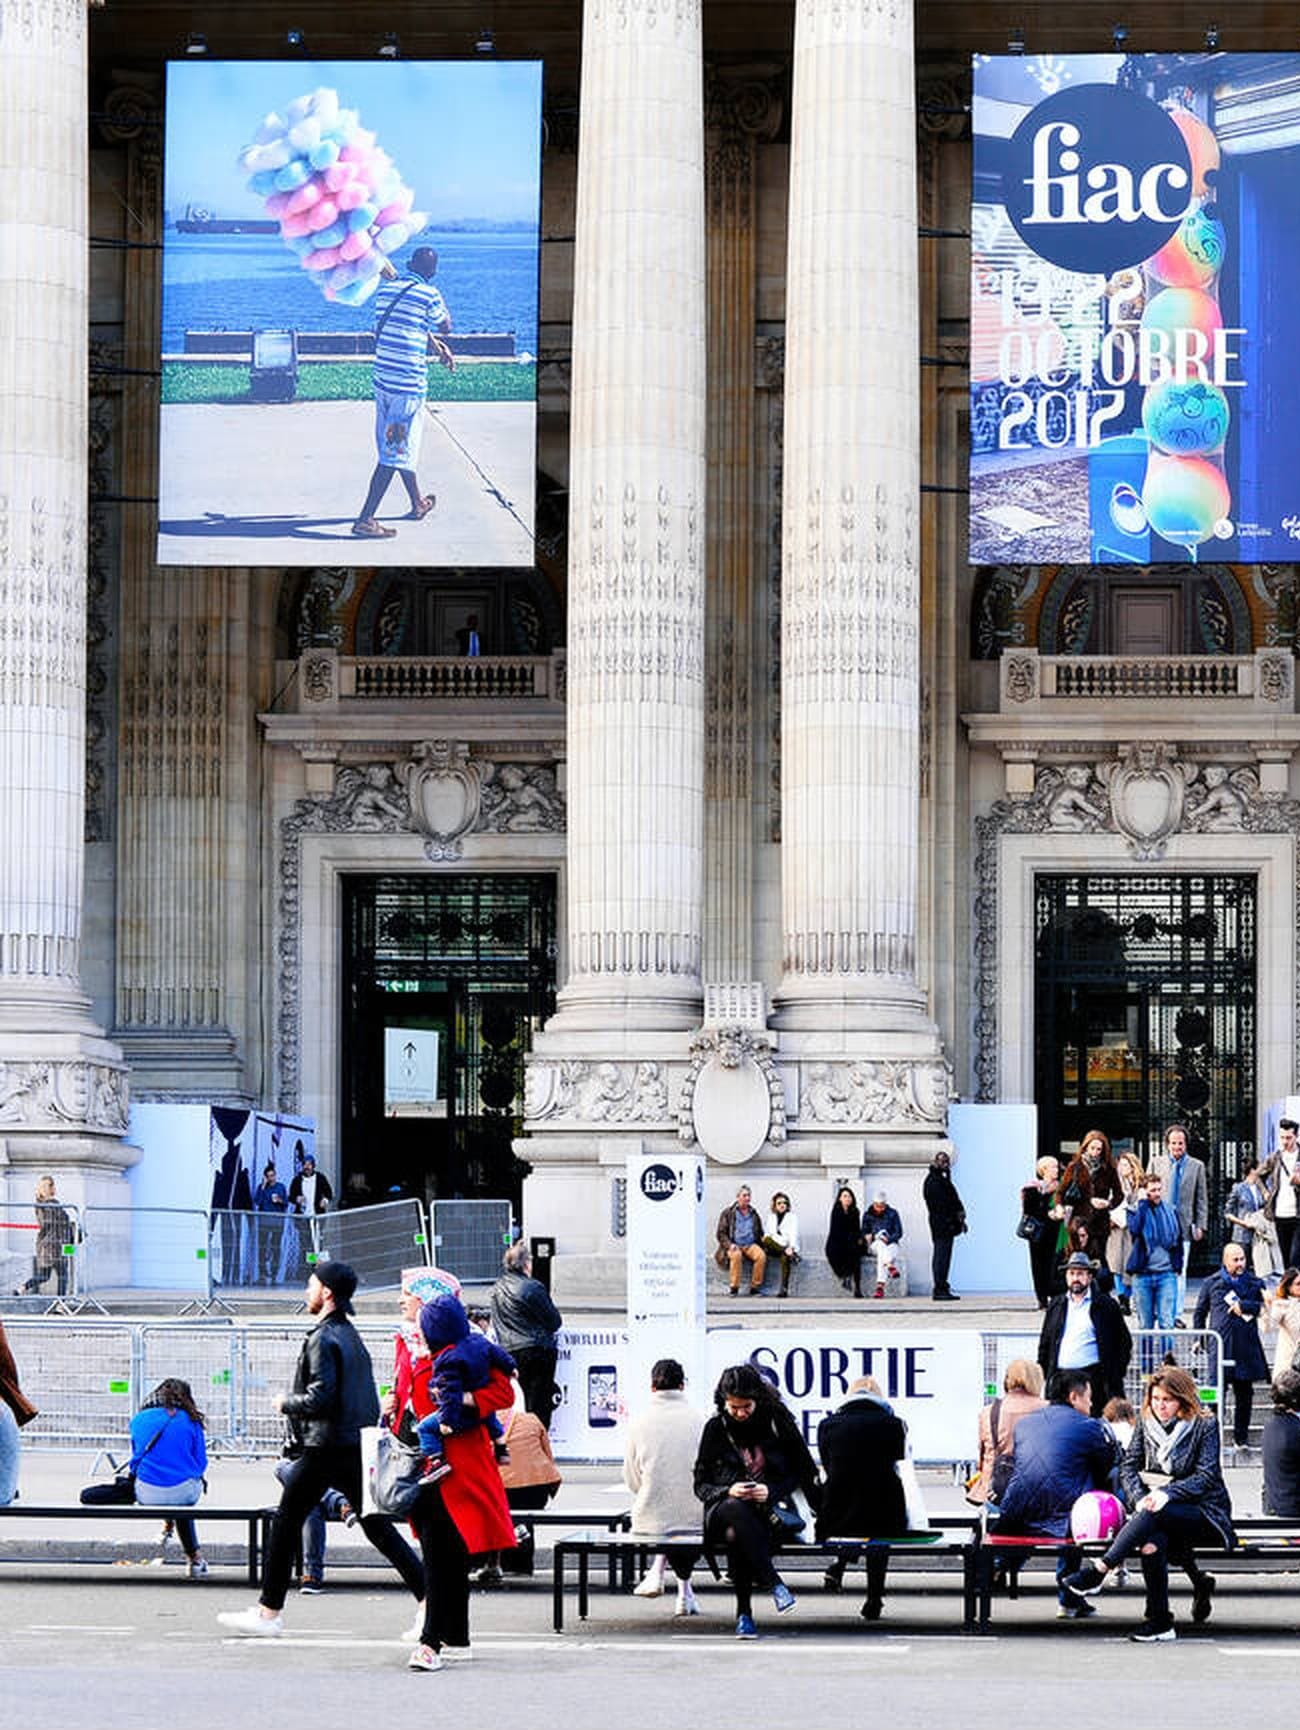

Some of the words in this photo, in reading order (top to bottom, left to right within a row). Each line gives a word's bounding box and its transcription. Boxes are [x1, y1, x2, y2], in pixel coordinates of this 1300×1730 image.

[1022, 122, 1190, 224] fiac
[1000, 327, 1248, 387] OCTOBRE
[999, 389, 1126, 449] 2017
[750, 1347, 935, 1398] SORTIE
